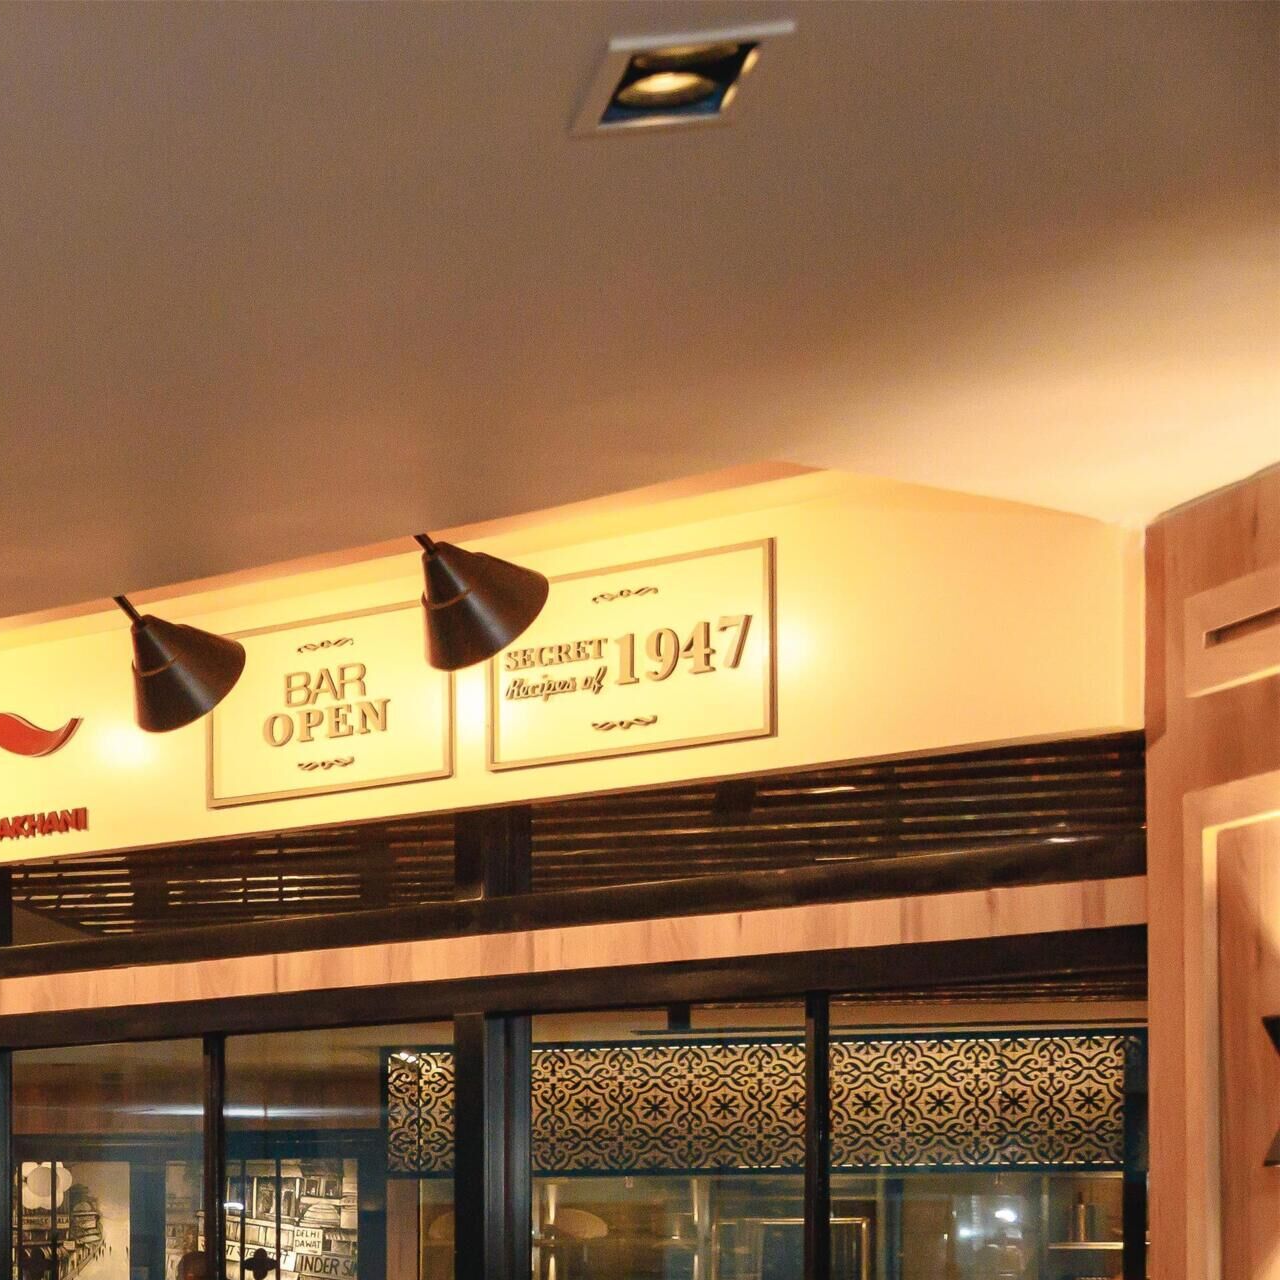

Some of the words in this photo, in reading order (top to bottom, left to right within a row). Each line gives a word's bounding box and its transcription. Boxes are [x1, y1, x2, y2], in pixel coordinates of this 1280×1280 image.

[504, 637, 608, 671] SECRET
[614, 614, 754, 686] 1947
[284, 662, 367, 708] BAR
[505, 675, 578, 702] Recipes
[580, 665, 608, 695] of
[263, 698, 391, 747] OPEN
[294, 1239, 322, 1250] DAWAT
[295, 1228, 321, 1239] DELHI
[300, 1255, 340, 1276] INDER
